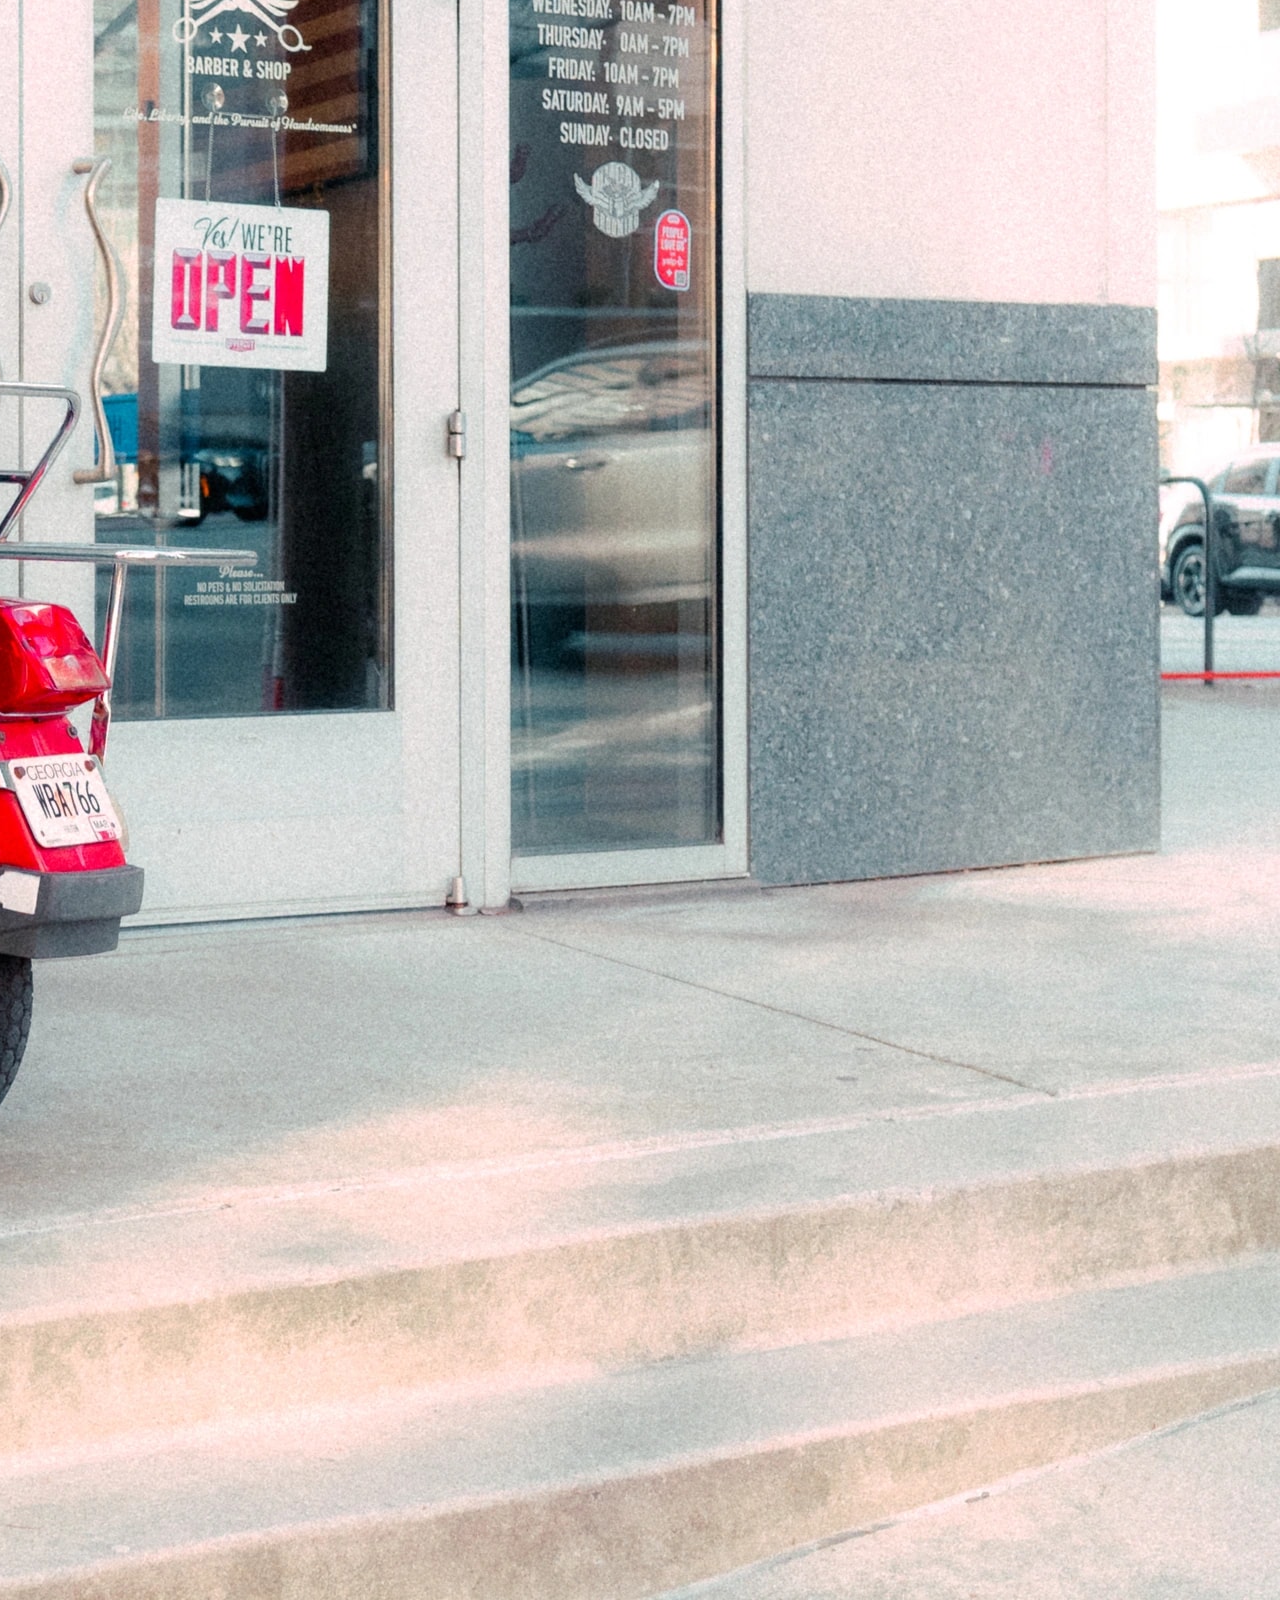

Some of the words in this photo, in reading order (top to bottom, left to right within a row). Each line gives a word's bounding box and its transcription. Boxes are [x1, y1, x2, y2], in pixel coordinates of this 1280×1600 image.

[620, 0, 655, 24] 10AM
[667, 4, 695, 28] 7PM
[662, 35, 690, 58] 7PM
[187, 55, 239, 78] BARBER
[243, 59, 253, 79] &
[256, 59, 292, 81] SHOP
[548, 57, 596, 82] FRIDAY:
[603, 61, 638, 86] 10AM
[652, 66, 680, 89] 7PM
[542, 88, 610, 115] SATURDAY:
[616, 95, 644, 118] 9AM
[657, 98, 685, 121] 5PM
[192, 111, 211, 125] and
[213, 112, 230, 126] the
[231, 112, 269, 129] Pursuit
[270, 115, 281, 132] of
[620, 126, 669, 151] CLOSED
[193, 216, 240, 250] Yes!
[241, 223, 293, 253] WE'RE
[171, 247, 306, 337] OPEN
[197, 581, 206, 593] NO
[208, 581, 224, 593] PETS
[232, 581, 242, 592] NO
[225, 594, 238, 605] ARE
[240, 594, 253, 605] FOR
[253, 593, 280, 604] CLIENTS
[280, 592, 298, 604] ONLY
[26, 761, 85, 781] GEORGIA
[32, 780, 101, 820] WBA766
